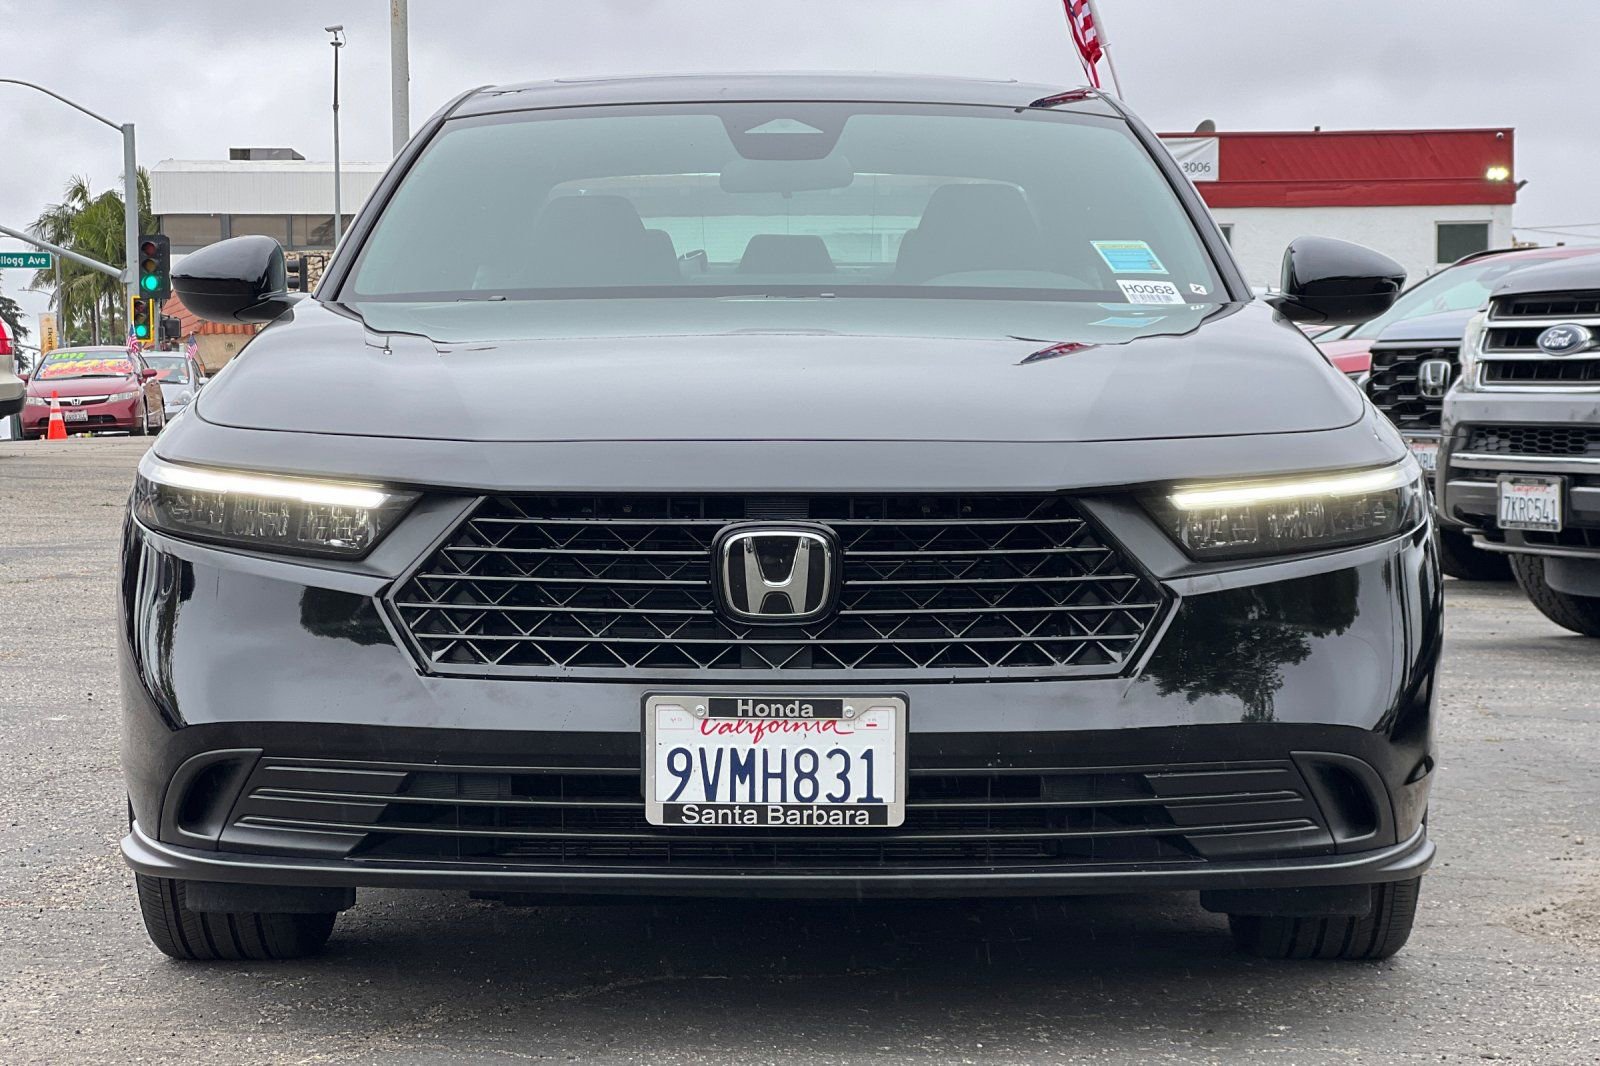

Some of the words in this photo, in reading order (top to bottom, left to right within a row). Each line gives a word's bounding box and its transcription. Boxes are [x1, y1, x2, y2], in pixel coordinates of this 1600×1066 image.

[1183, 162, 1211, 173] 3006
[0, 255, 24, 266] llogg
[28, 255, 47, 265] Ave
[1122, 284, 1175, 295] H0068
[1544, 329, 1573, 347] Ford
[1503, 496, 1557, 523] 7KRC541
[737, 699, 814, 718] Honda
[700, 718, 855, 744] California
[665, 746, 884, 803] 9VMH831
[681, 804, 758, 825] Santa
[767, 804, 870, 825] Barbara
